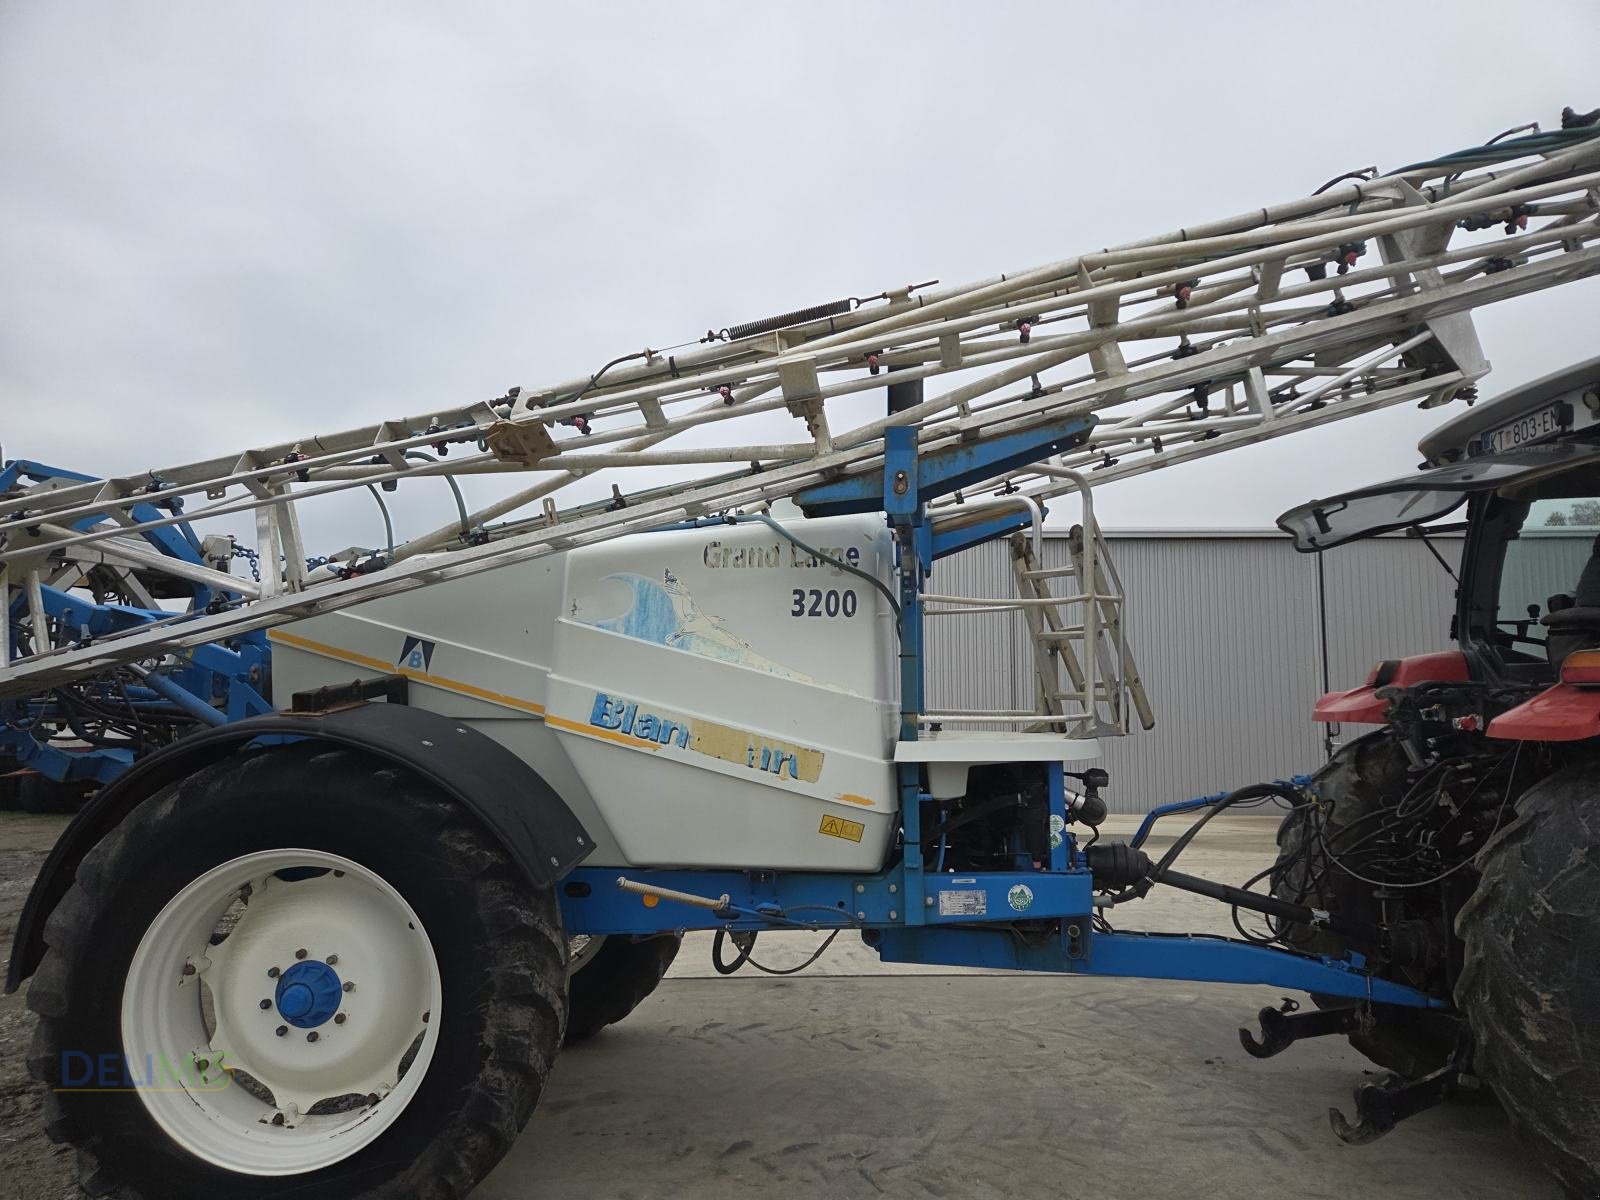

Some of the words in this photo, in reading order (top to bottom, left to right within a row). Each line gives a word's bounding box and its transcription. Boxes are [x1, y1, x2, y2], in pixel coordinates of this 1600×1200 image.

[1491, 430, 1505, 452] KT
[703, 541, 780, 568] Grand
[791, 588, 857, 618] 3200
